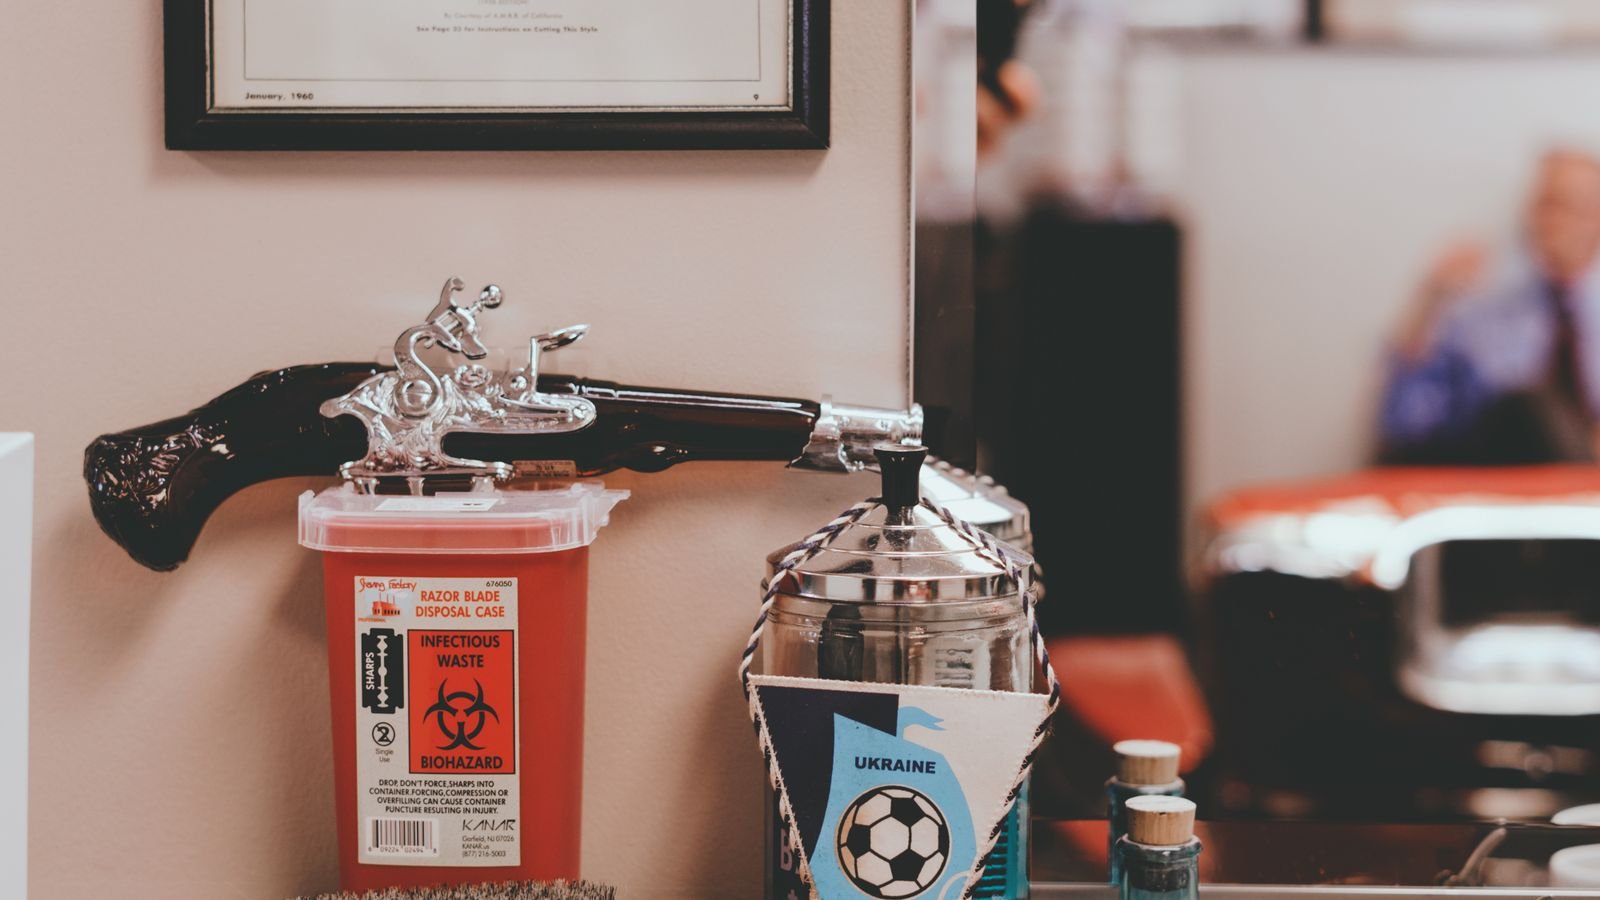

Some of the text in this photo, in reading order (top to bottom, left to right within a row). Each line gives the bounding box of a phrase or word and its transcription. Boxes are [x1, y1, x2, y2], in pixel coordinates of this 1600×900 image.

[432, 26, 450, 34] Page
[534, 26, 560, 34] Cutting
[291, 92, 314, 100] 1960
[421, 590, 500, 602] RAZOR BLADE
[415, 606, 505, 617] DISPOSAL CASE
[421, 635, 500, 648] INFECTIOUS
[437, 654, 484, 668] WASTE
[365, 652, 375, 690] SHARPS
[421, 756, 503, 769] BIOHAZARD
[854, 756, 936, 774] UKRAINE
[424, 806, 461, 814] RESULTING
[462, 819, 516, 831] KANAR
